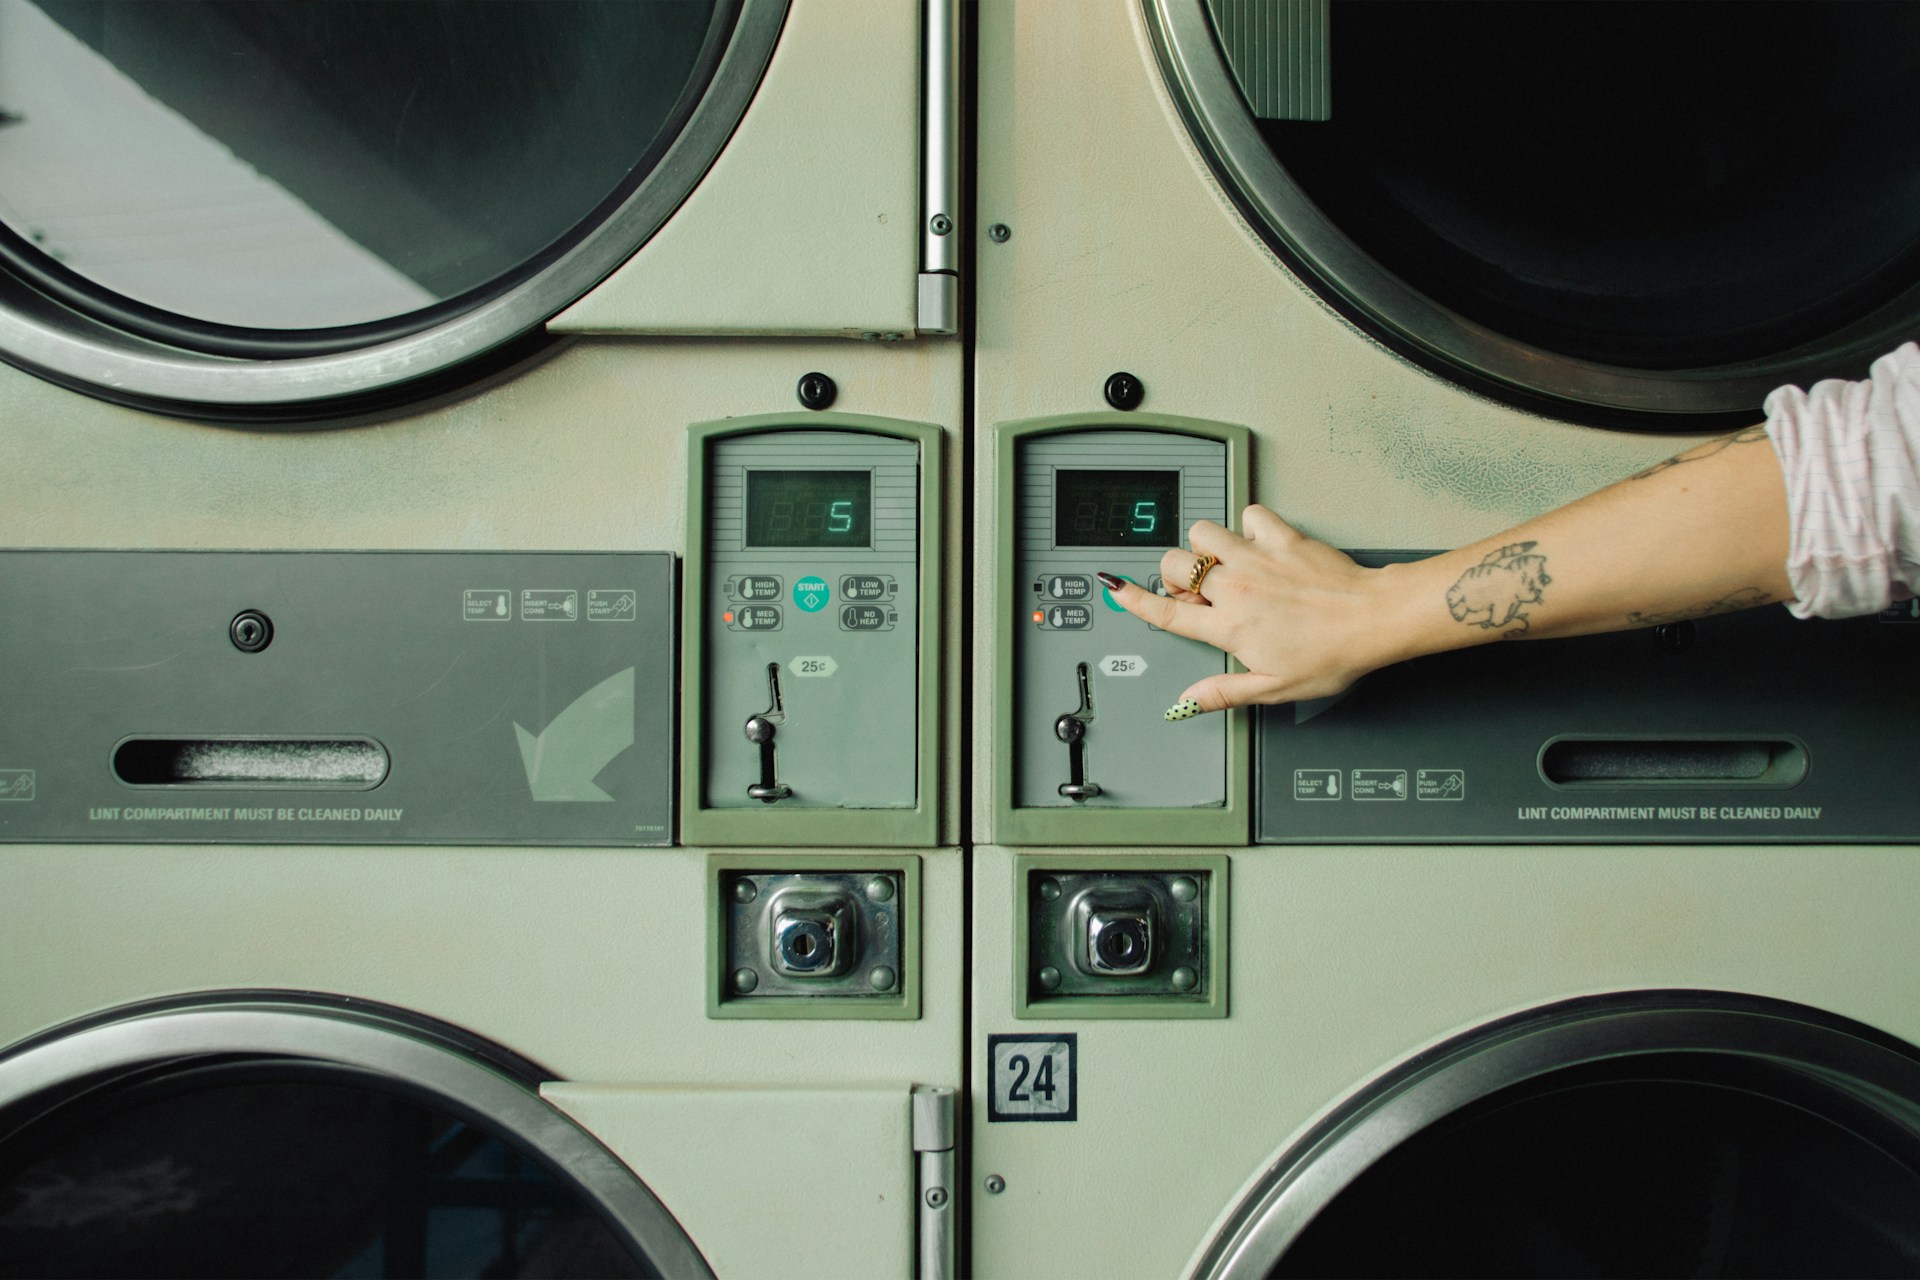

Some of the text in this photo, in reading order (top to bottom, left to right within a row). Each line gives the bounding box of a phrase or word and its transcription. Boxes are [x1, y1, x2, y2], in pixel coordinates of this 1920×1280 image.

[798, 583, 826, 591] START
[467, 591, 472, 599] 1
[524, 591, 531, 599] 2
[590, 591, 597, 599] 3
[754, 588, 776, 596] TEMP
[859, 588, 881, 596] TEMP
[1064, 588, 1086, 596] TEMP
[754, 617, 776, 625] TEMP
[801, 661, 826, 672] 25¢
[1111, 660, 1136, 672] 25¢
[1297, 771, 1302, 779] 1
[1354, 771, 1361, 779] 2
[1420, 771, 1426, 779] 3
[90, 807, 403, 821] LINT COMPARTMENT MUST BE CLEANED DAILY
[1518, 807, 1822, 820] LINT COMPARTMENT MUST BE CLEANED DAILY
[1008, 1054, 1056, 1101] 24
